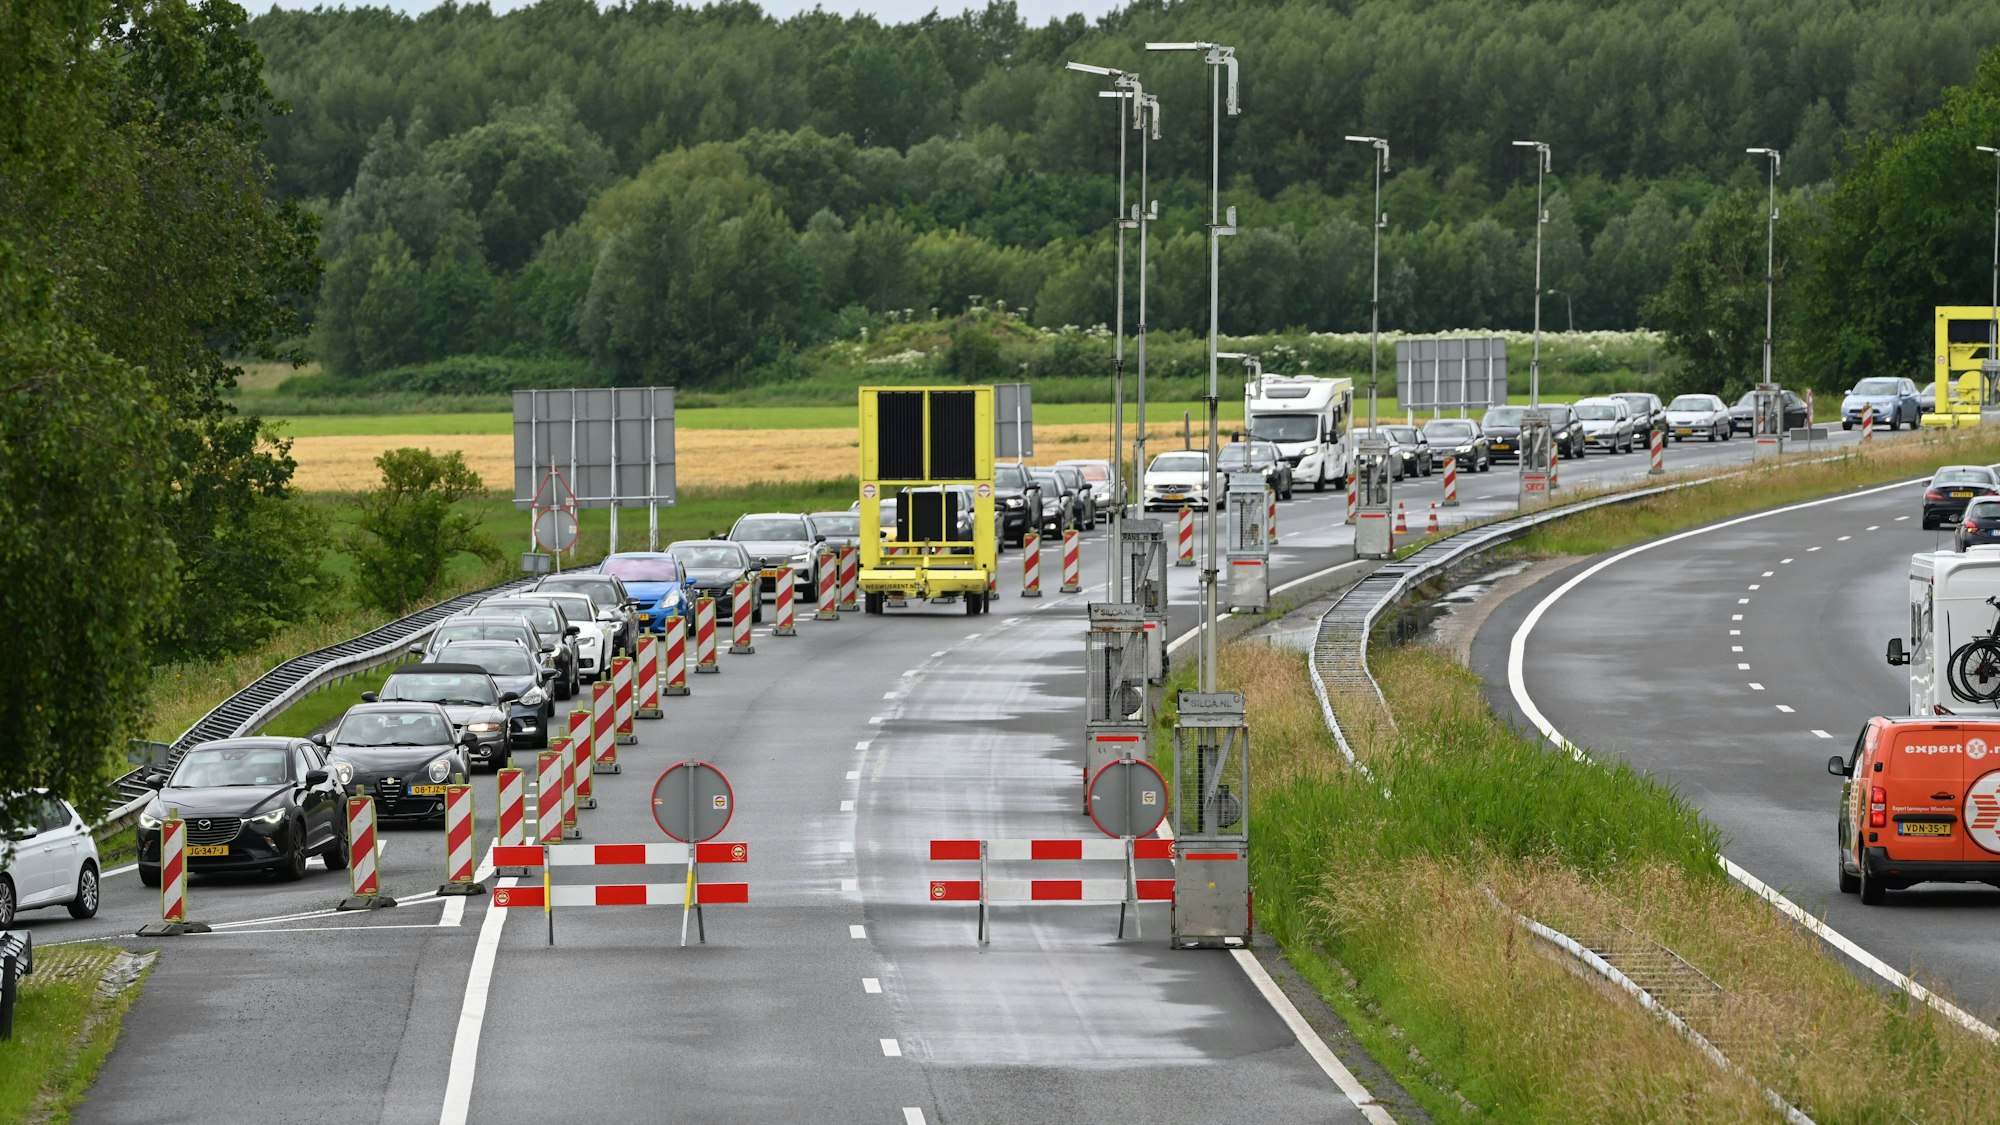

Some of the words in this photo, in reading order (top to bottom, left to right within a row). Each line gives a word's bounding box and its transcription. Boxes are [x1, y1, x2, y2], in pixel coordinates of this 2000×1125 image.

[1100, 608, 1134, 616] SILCA.NL
[1190, 700, 1232, 708] SILCA.NL
[1905, 744, 1963, 754] expert
[1906, 823, 1948, 833] VDN-35-T
[190, 847, 224, 855] JG-347-J
